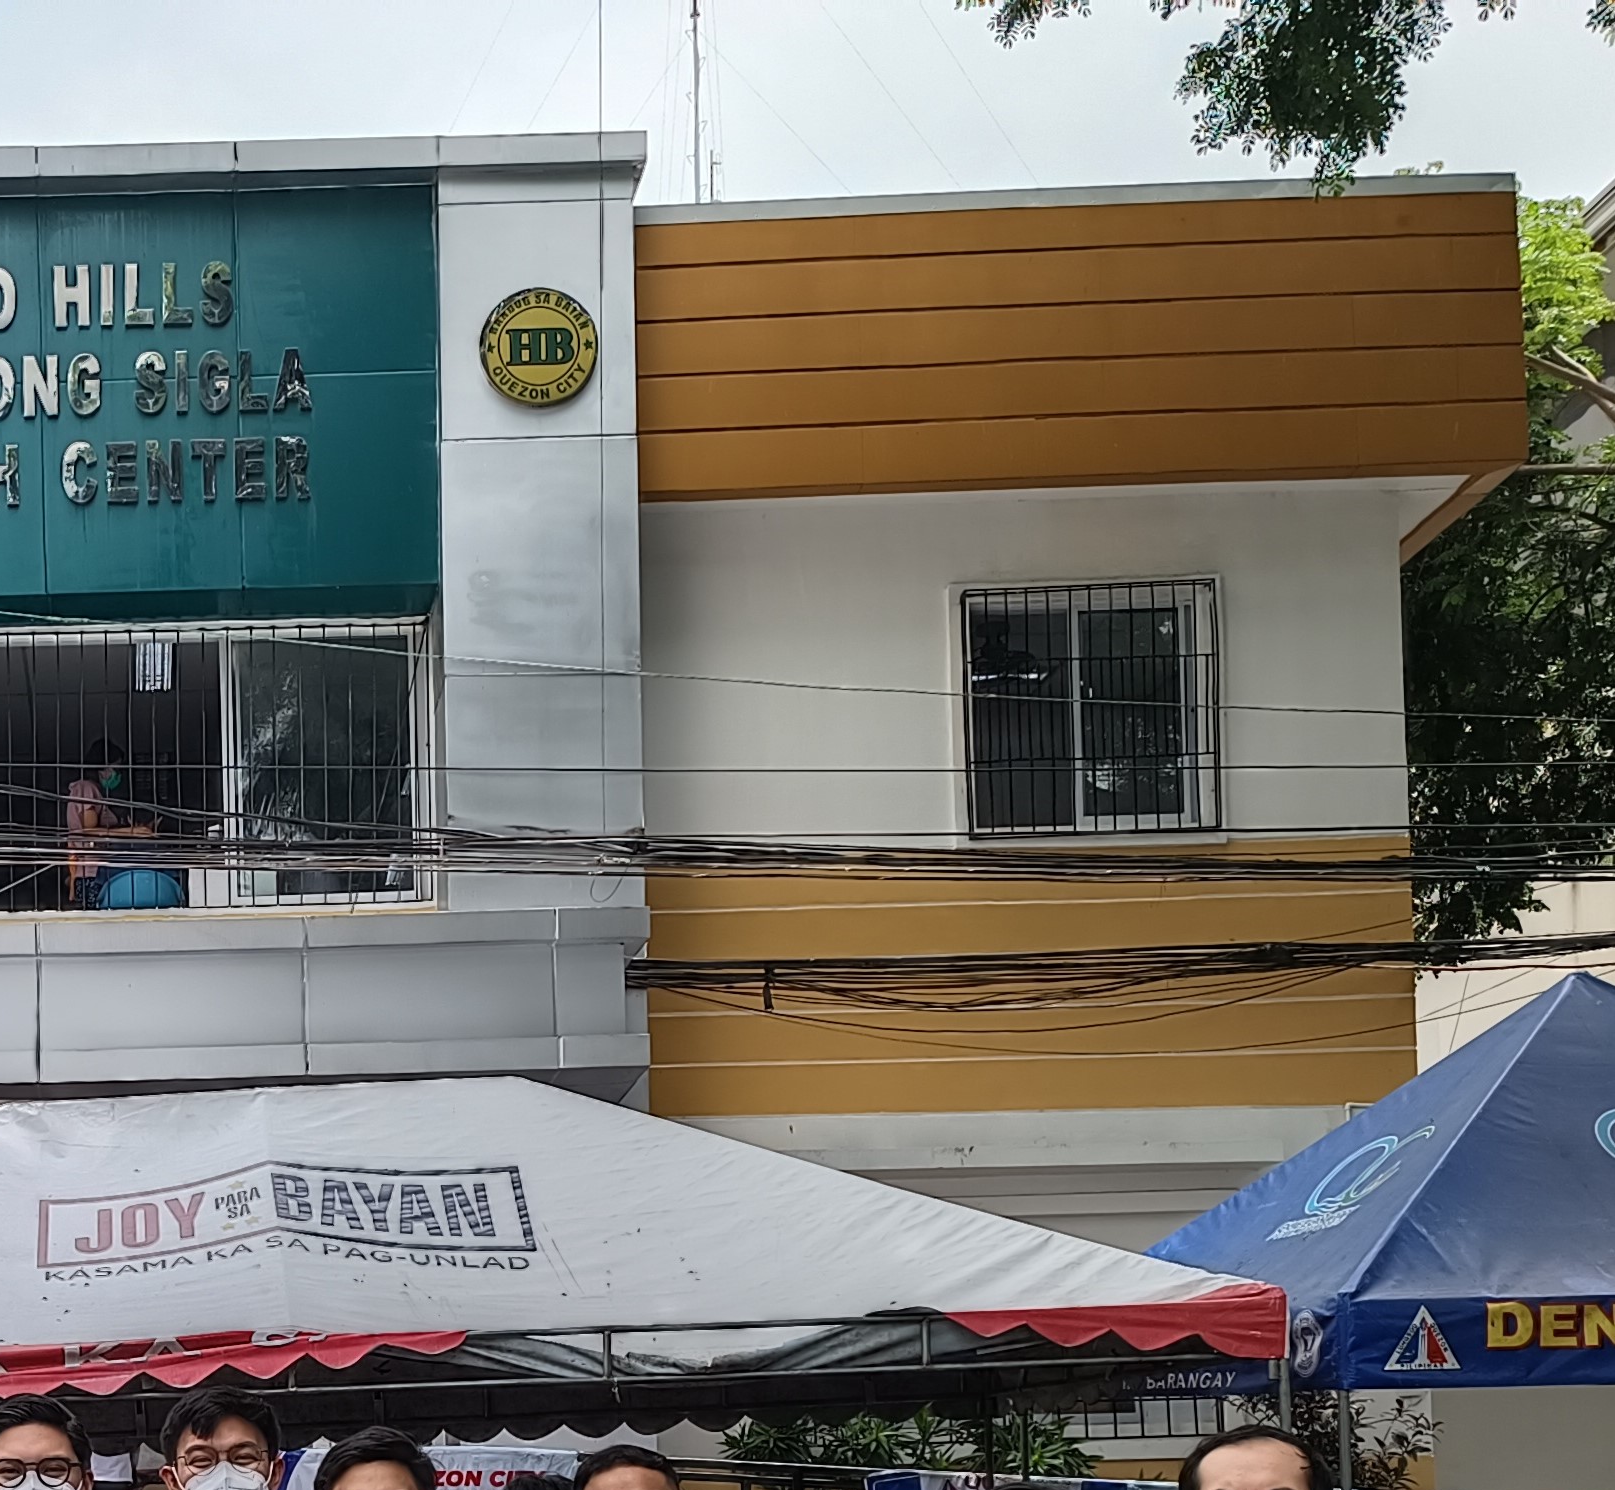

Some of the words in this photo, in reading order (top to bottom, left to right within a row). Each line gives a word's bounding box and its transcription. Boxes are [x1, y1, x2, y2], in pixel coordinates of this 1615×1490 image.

[52, 261, 234, 329] HILLS
[505, 327, 575, 366] HB
[133, 347, 313, 415] SIGLA
[492, 365, 550, 400] QUEZON
[556, 363, 586, 394] CITY
[61, 436, 312, 504] CENTER
[74, 1191, 205, 1255] JOY
[214, 1186, 261, 1210] PARA
[271, 1172, 496, 1237] BAYAN
[227, 1204, 252, 1219] SA
[44, 1256, 193, 1282] KASAMA
[206, 1243, 253, 1261] KA
[265, 1235, 311, 1253] SA
[323, 1243, 531, 1271] PAG-UNLAD
[1486, 1301, 1615, 1348] DEN
